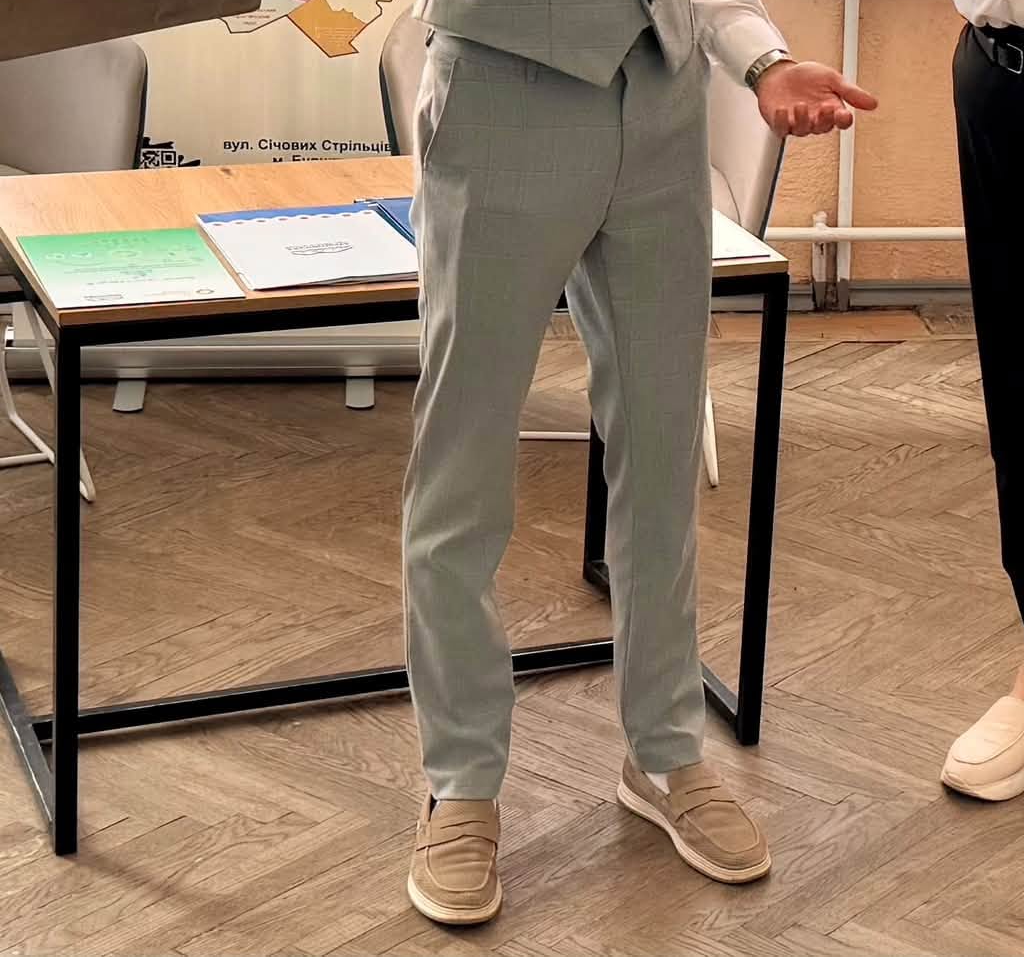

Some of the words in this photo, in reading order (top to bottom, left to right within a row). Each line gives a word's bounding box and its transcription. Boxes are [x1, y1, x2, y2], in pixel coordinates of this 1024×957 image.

[223, 140, 253, 152] вул.
[258, 139, 317, 151] Січових
[321, 139, 391, 153] Стрільців
